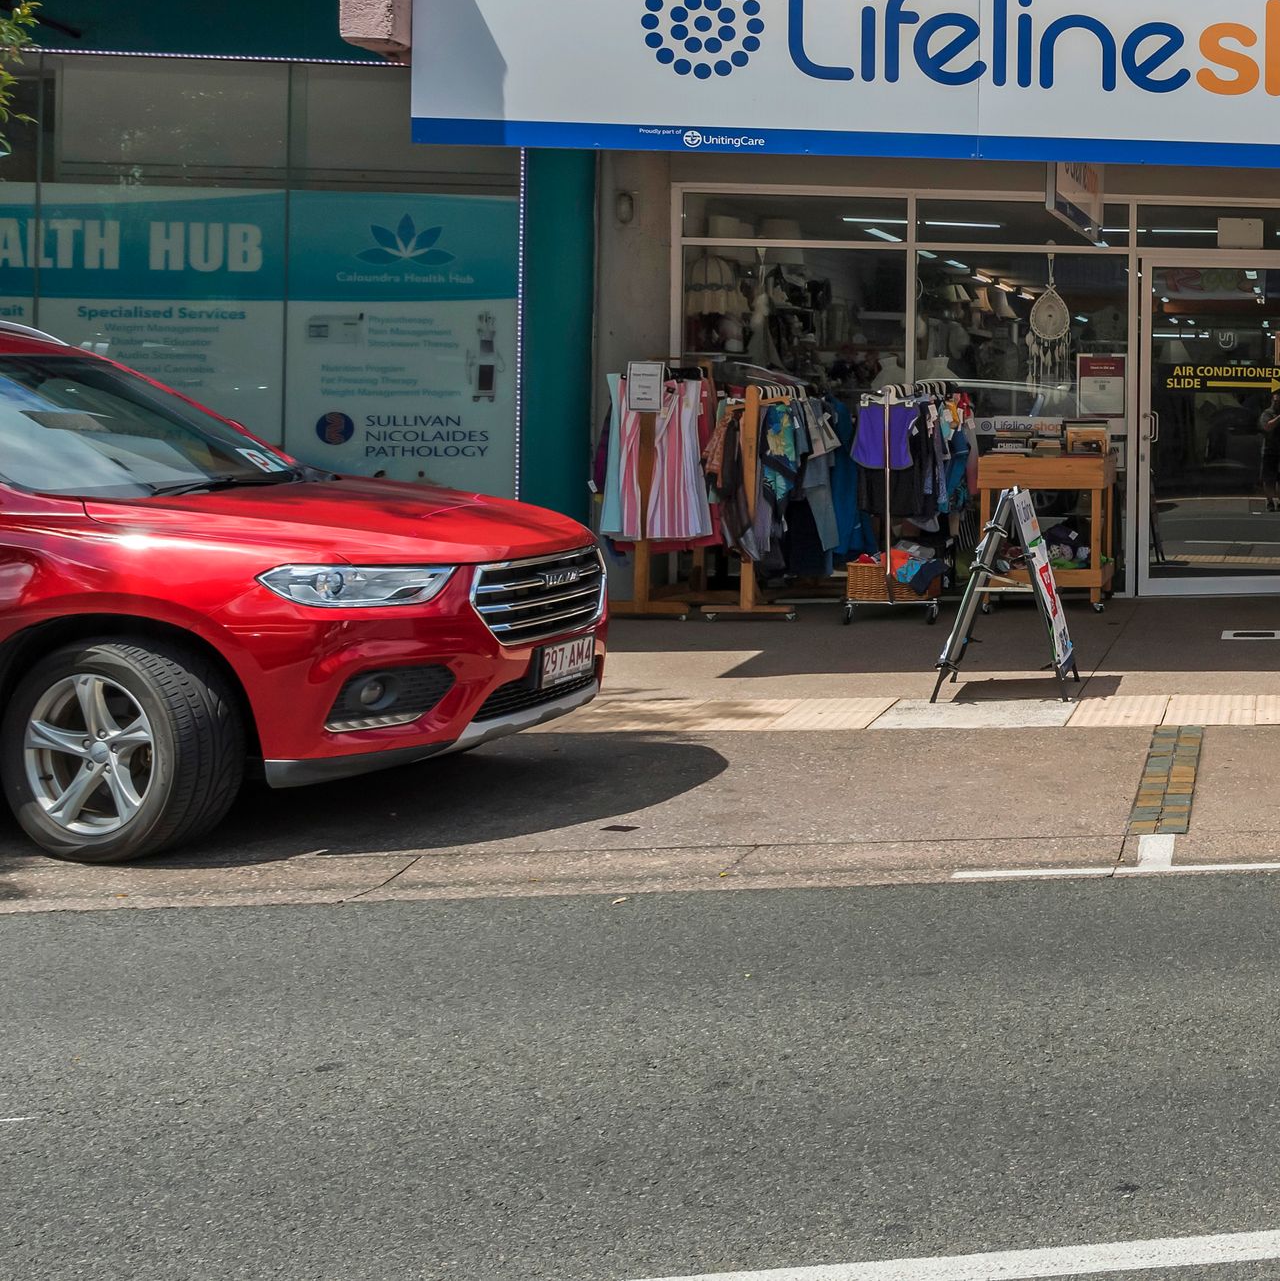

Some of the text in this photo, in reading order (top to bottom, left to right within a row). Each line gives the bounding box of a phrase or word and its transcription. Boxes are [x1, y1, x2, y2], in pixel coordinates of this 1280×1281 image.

[703, 135, 765, 148] UnitingCare
[149, 221, 263, 273] HUB
[404, 272, 445, 283] Health
[77, 305, 246, 321] Specialised Services
[1172, 366, 1280, 378] AIR CONDITIONED
[1166, 378, 1201, 389] SLIDE
[366, 415, 461, 427] SULLIVAN
[365, 430, 489, 442] NICOLAIDES
[365, 445, 489, 458] PATHOLOGY
